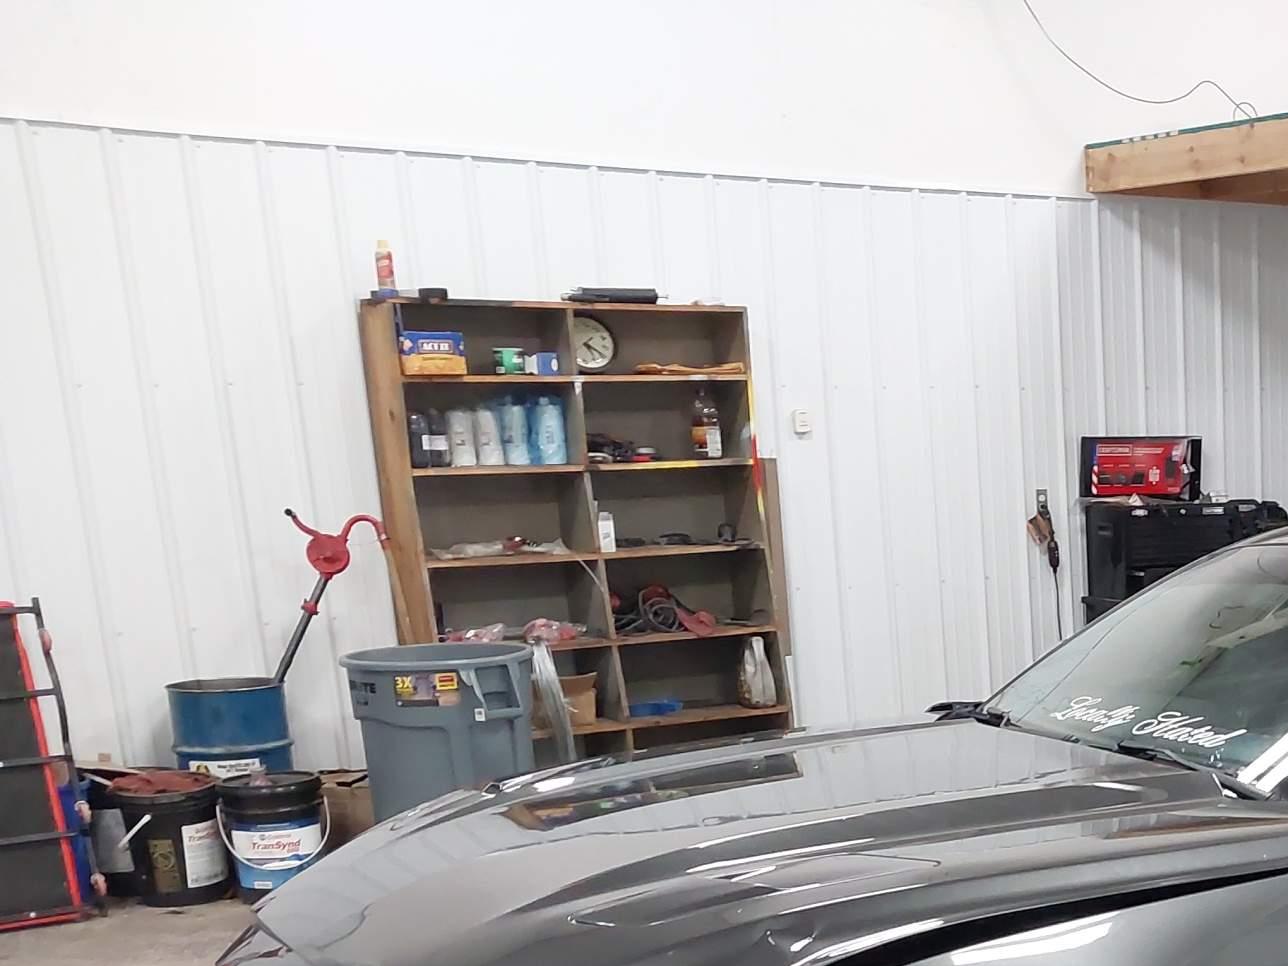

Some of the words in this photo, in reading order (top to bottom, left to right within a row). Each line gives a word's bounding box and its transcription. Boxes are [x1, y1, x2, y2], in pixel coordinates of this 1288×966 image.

[394, 676, 412, 689] 3X
[1050, 696, 1141, 732] Locally
[1131, 711, 1248, 748] Hated
[250, 838, 302, 851] TranSynd
